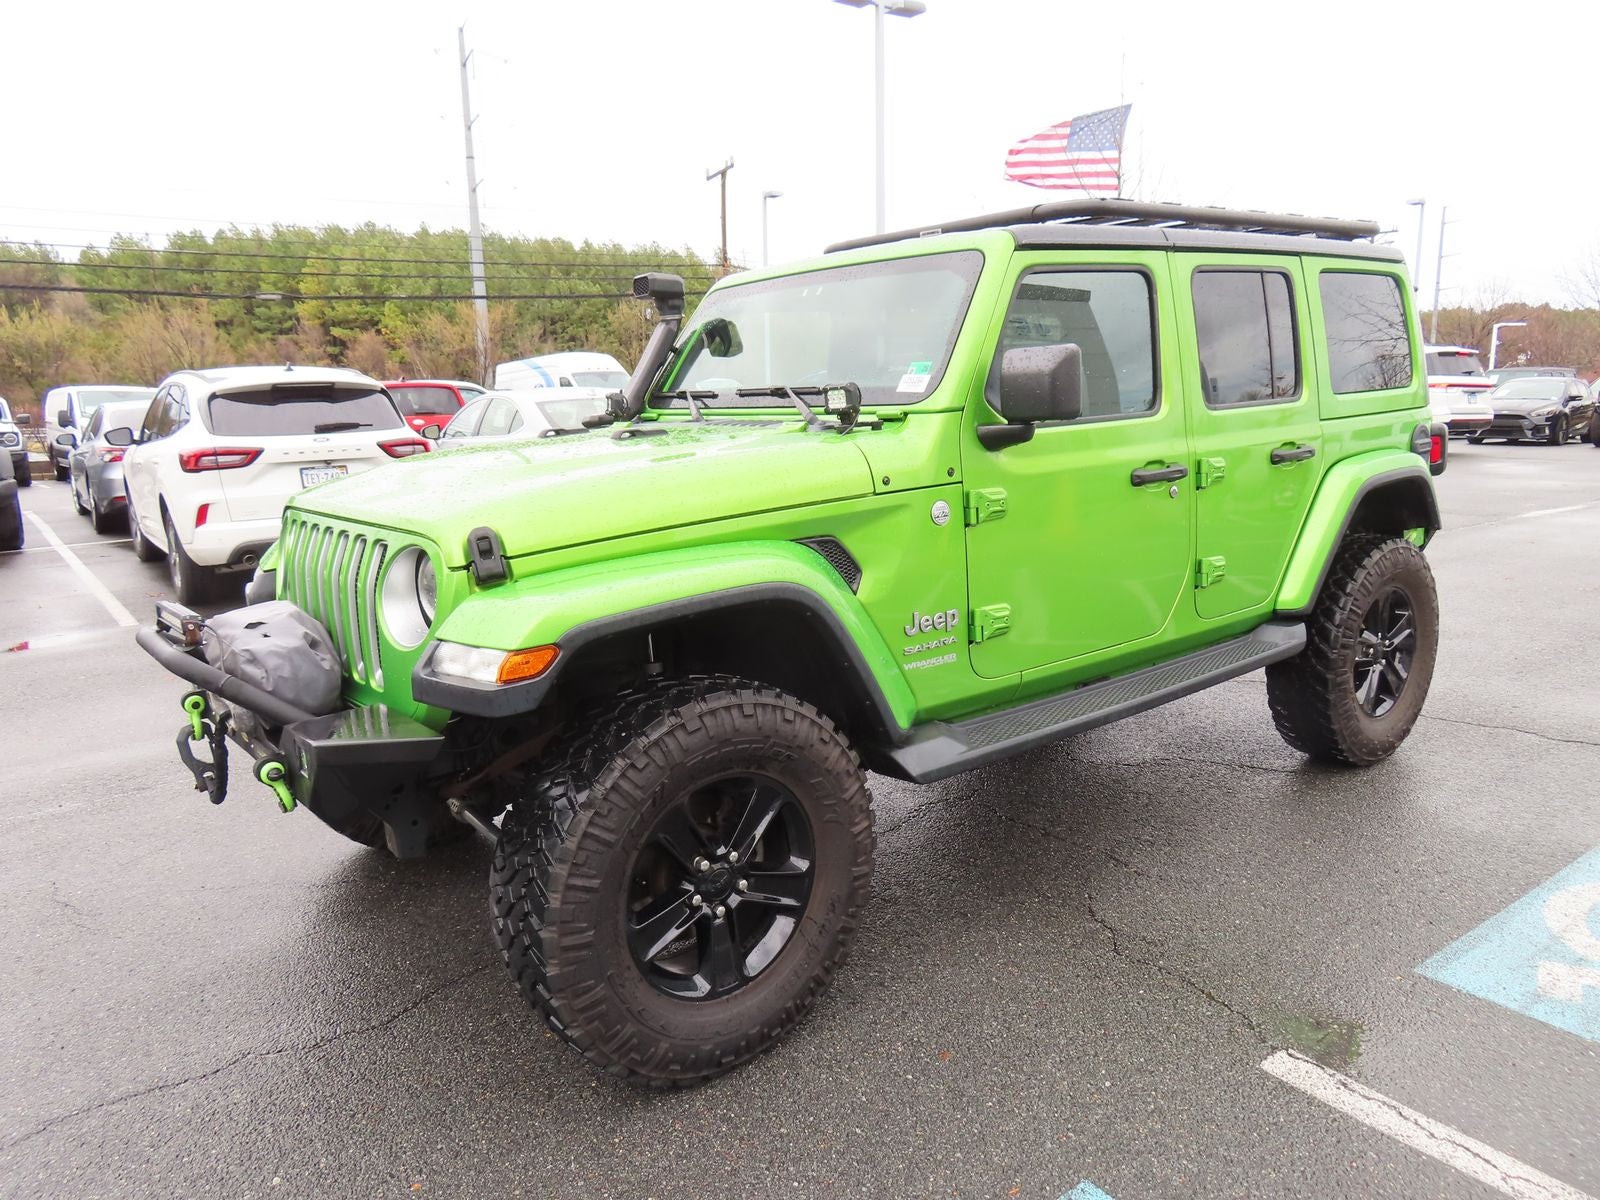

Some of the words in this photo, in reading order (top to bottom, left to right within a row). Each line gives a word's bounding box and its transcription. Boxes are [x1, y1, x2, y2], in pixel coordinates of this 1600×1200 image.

[904, 609, 959, 637] Jeep
[903, 636, 957, 656] SAHARA
[903, 653, 957, 671] WRANGLER
